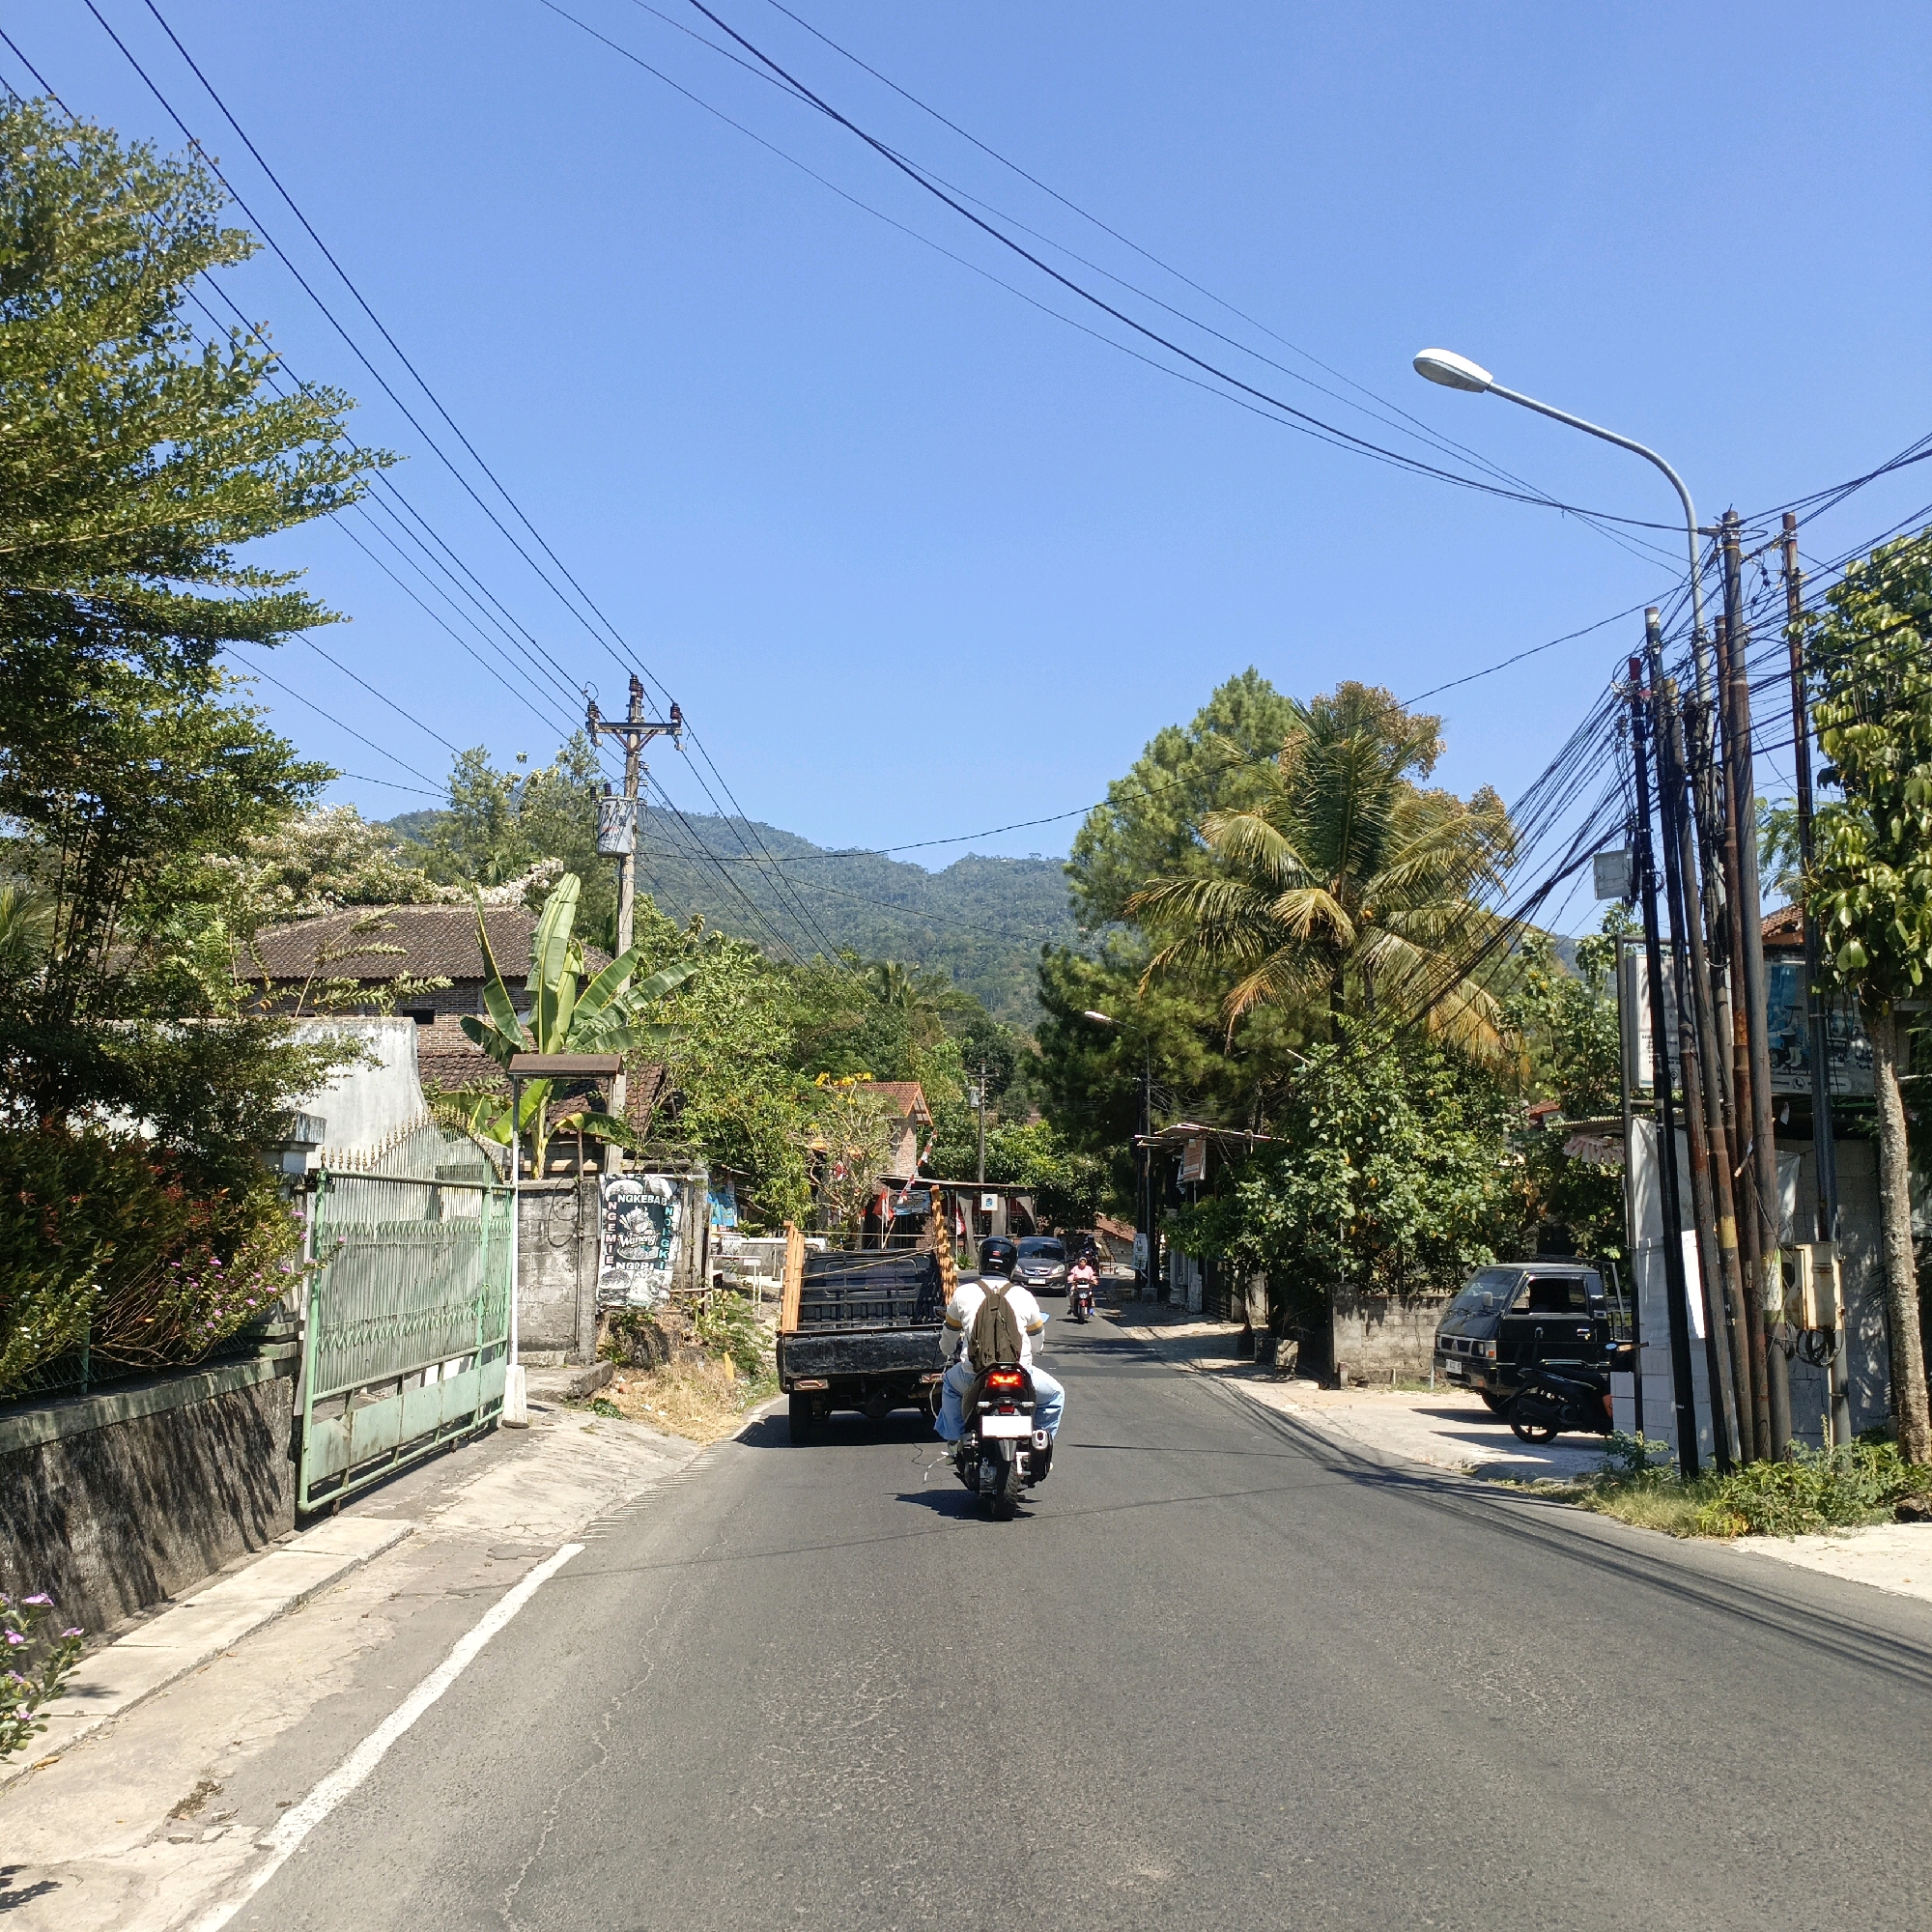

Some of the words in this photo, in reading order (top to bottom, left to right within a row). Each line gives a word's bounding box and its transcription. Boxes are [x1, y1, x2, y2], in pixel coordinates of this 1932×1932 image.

[618, 1194, 668, 1206] NGKEBAB
[606, 1202, 617, 1264] NGEMIE
[659, 1207, 673, 1270] NONGKI
[616, 1262, 654, 1270] NGOPI
